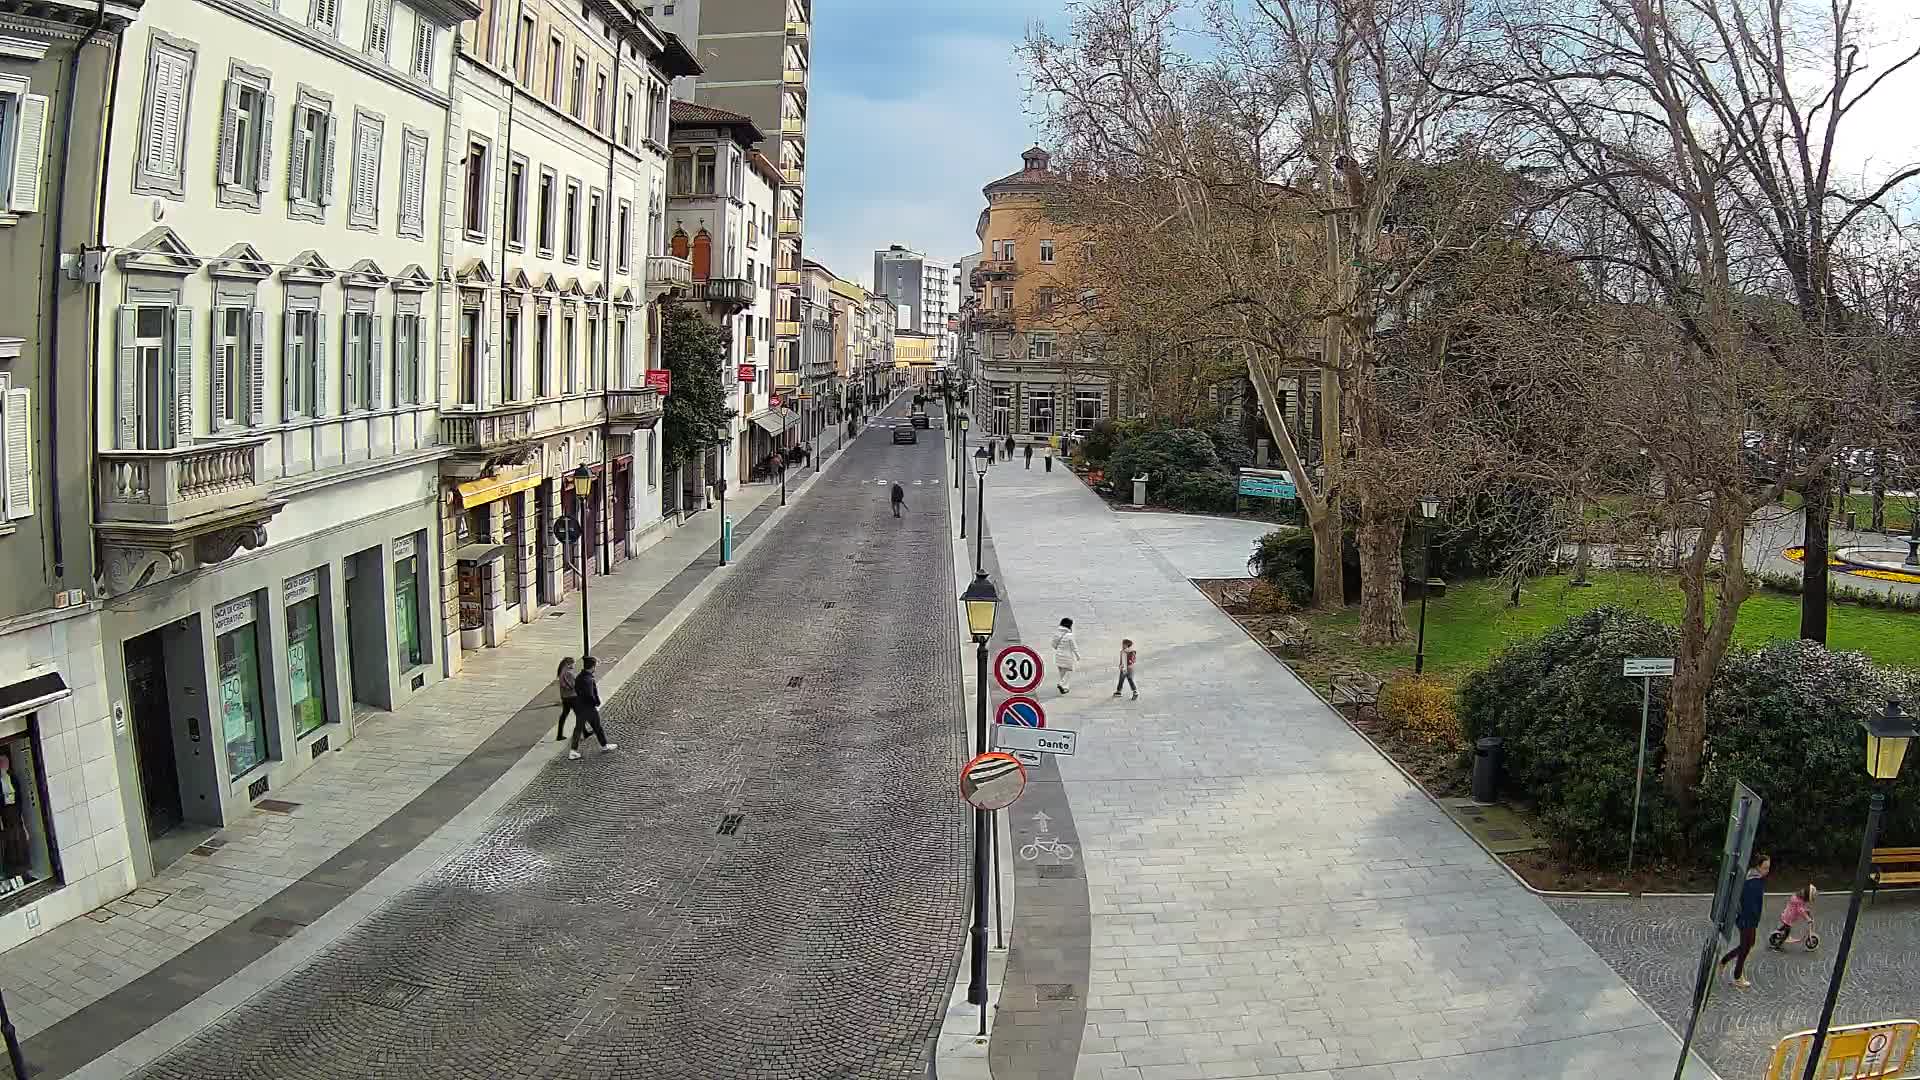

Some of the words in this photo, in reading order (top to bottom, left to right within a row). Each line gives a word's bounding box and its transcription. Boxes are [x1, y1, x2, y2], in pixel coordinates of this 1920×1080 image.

[1005, 659, 1033, 680] 30
[222, 678, 240, 700] 130
[1038, 738, 1070, 750] Dante
